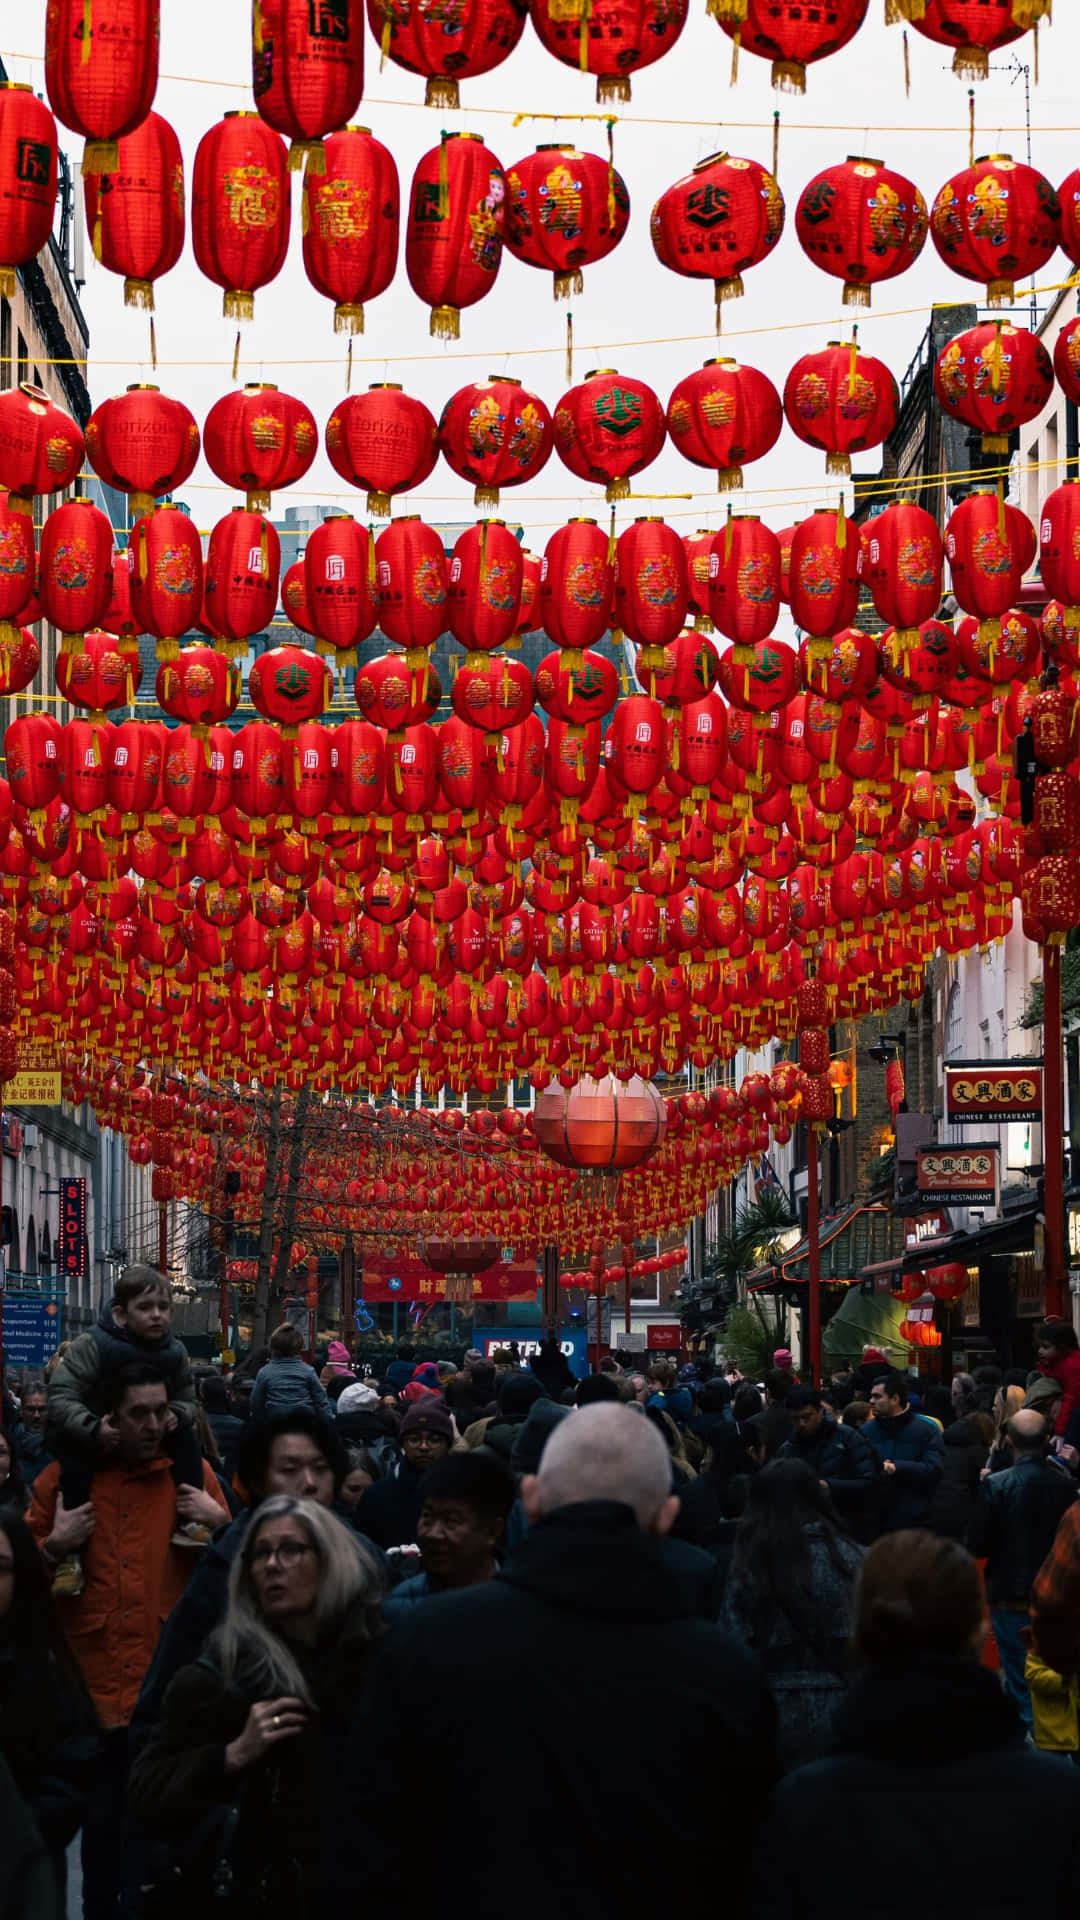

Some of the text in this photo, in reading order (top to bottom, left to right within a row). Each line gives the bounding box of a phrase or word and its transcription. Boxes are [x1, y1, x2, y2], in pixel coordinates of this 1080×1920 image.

[988, 1112, 1036, 1120] RESTAURANT
[922, 1193, 993, 1202] CHINESE RESTAURANT
[66, 1185, 79, 1268] SLOTS
